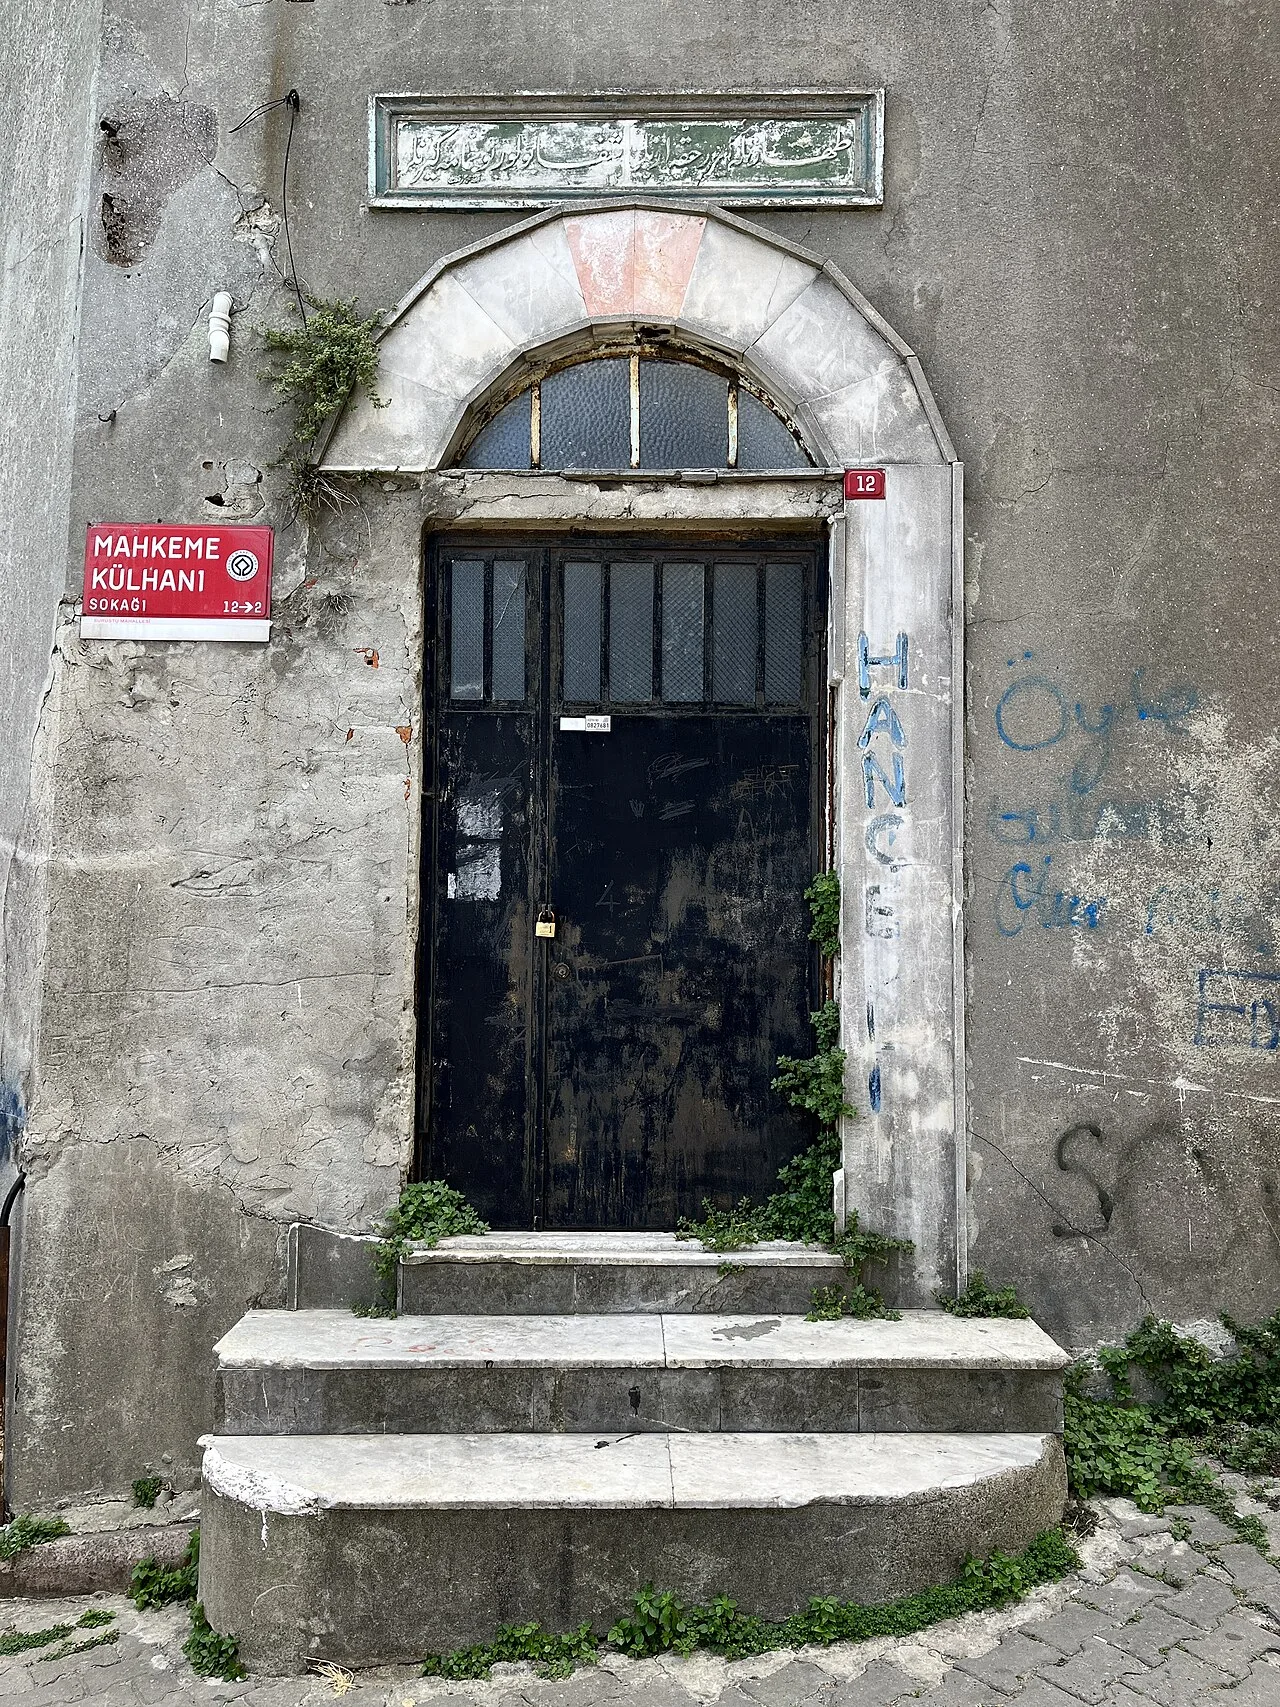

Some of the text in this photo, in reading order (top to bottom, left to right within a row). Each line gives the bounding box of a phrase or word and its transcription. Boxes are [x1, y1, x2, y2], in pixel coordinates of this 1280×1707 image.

[857, 475, 876, 492] 12
[94, 535, 221, 560] MAHKEME
[91, 563, 206, 592] KÜLHANI
[88, 597, 147, 612] SOKAĞI
